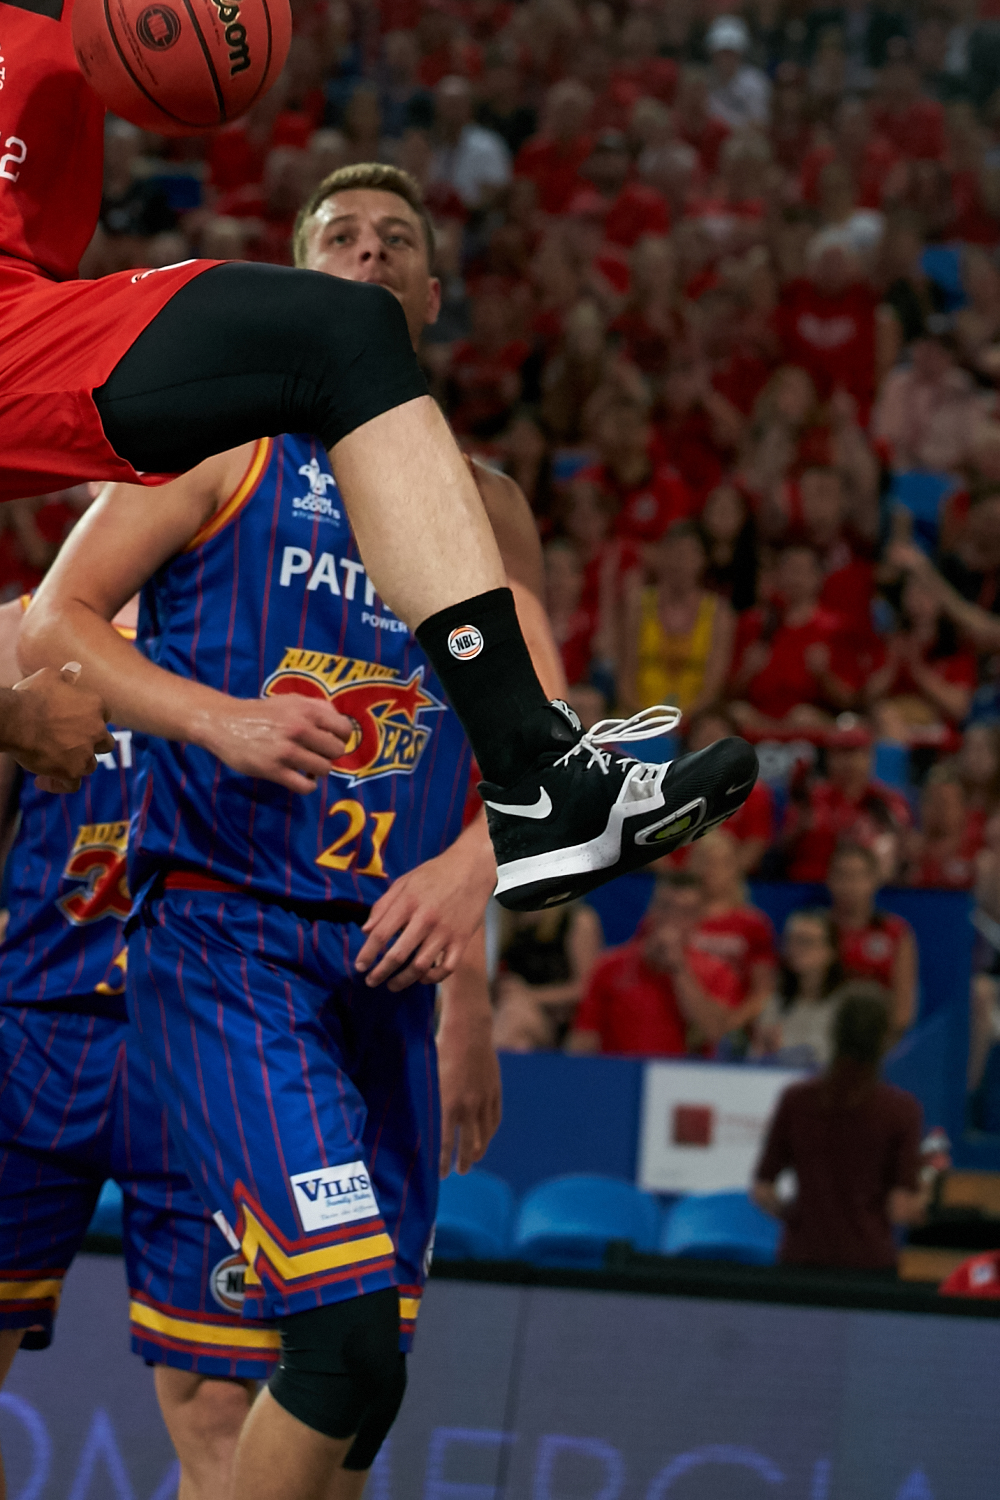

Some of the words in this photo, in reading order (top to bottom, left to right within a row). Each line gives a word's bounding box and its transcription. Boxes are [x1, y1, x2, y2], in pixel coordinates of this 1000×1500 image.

[361, 611, 409, 633] POWER
[455, 634, 477, 651] NBL
[315, 799, 397, 879] 21
